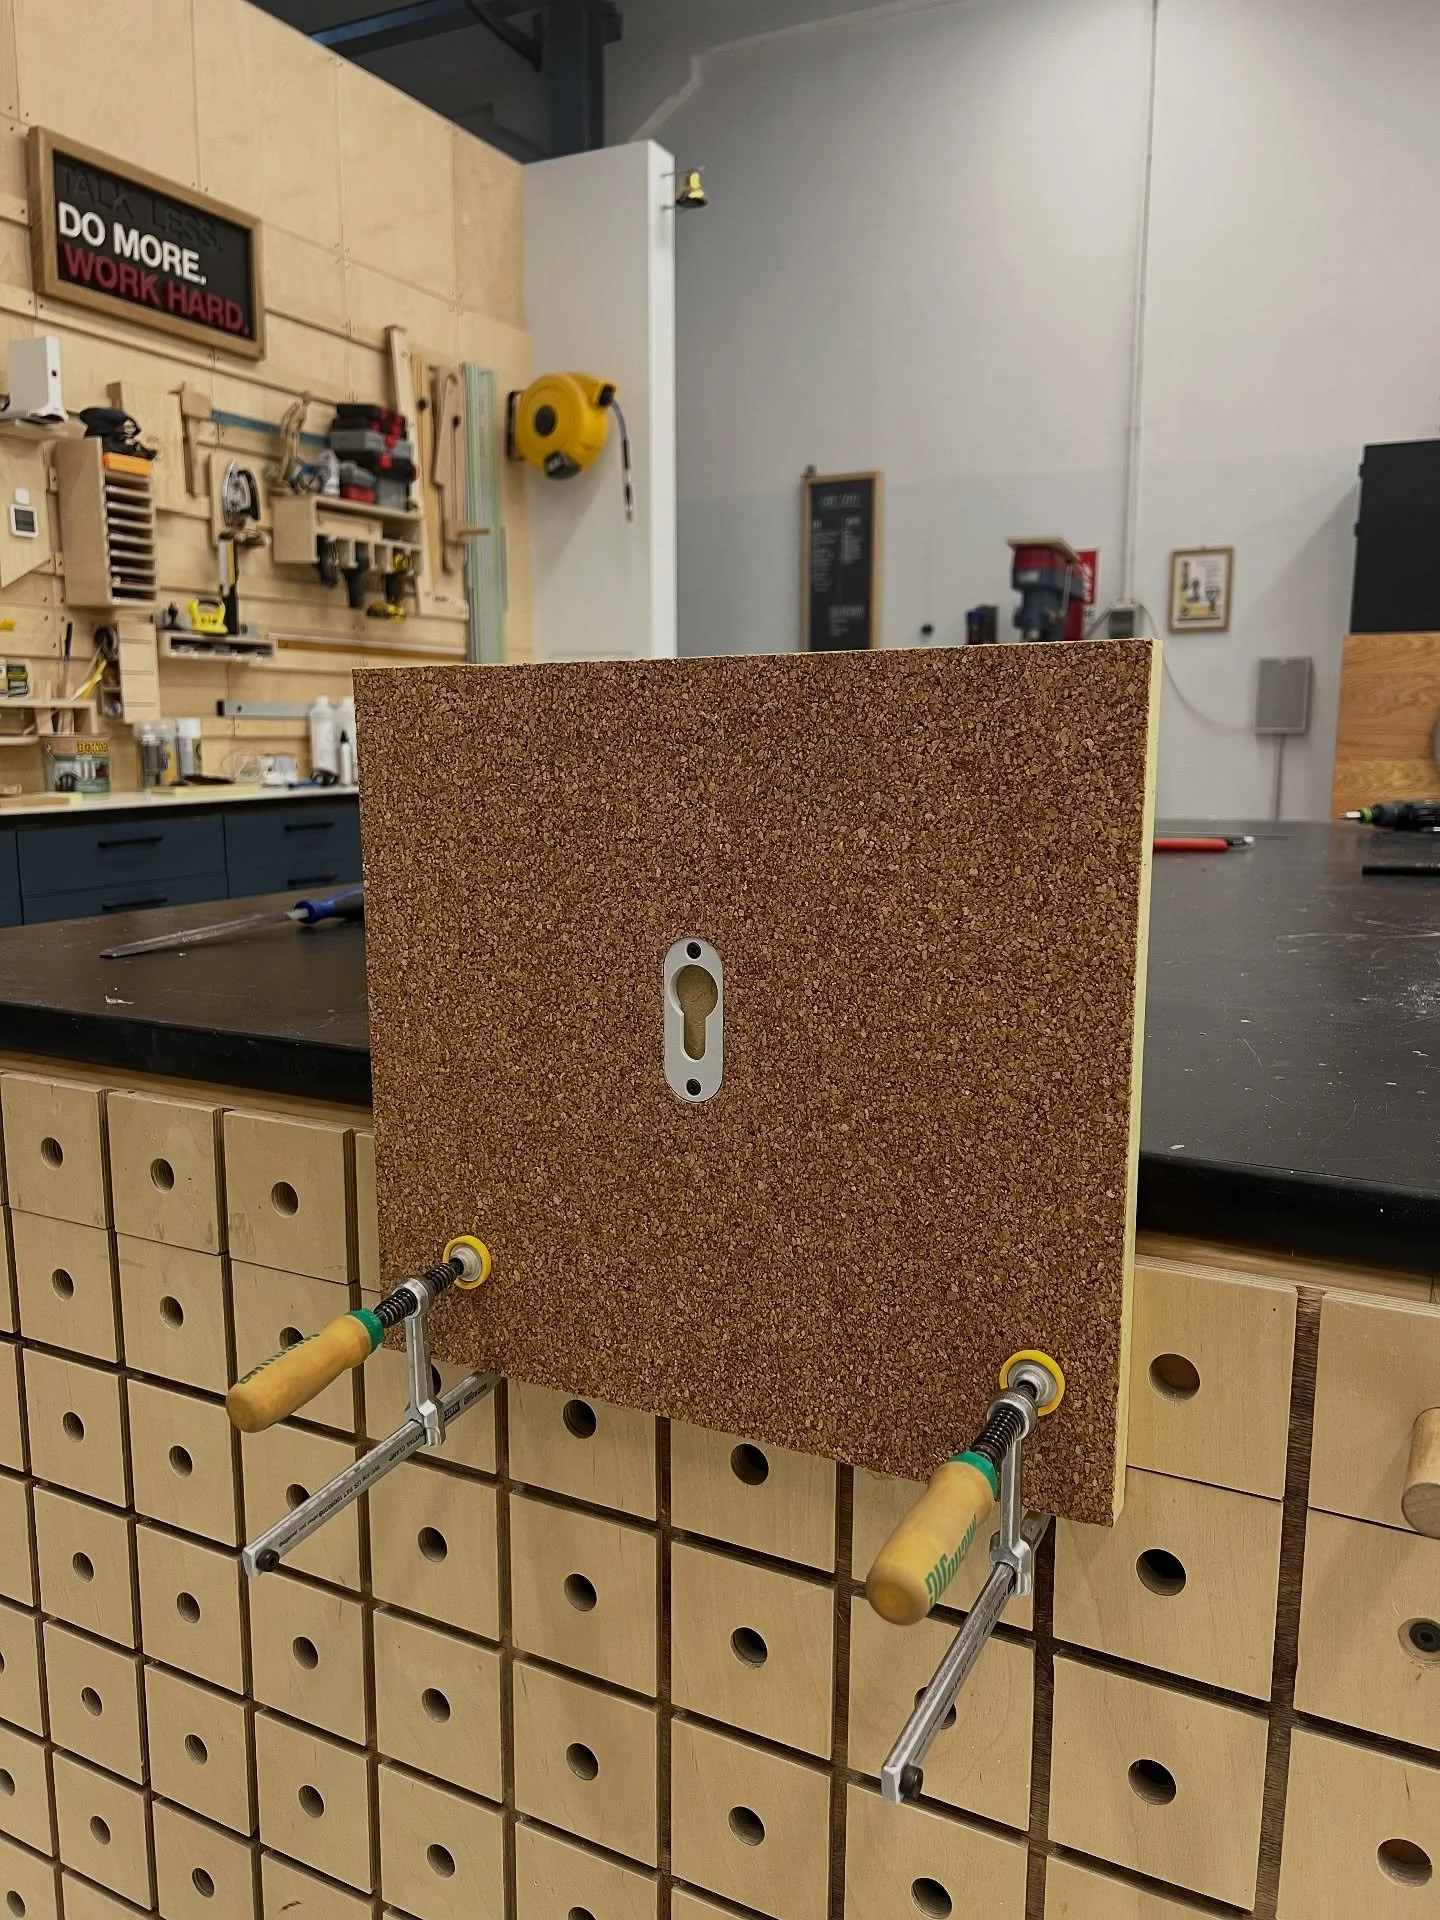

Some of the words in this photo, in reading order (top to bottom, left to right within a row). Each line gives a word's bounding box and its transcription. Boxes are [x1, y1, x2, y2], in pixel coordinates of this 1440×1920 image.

[58, 201, 106, 247] DO
[113, 222, 207, 285] MORE.
[63, 242, 160, 306] WORK
[167, 280, 250, 336] HARD.
